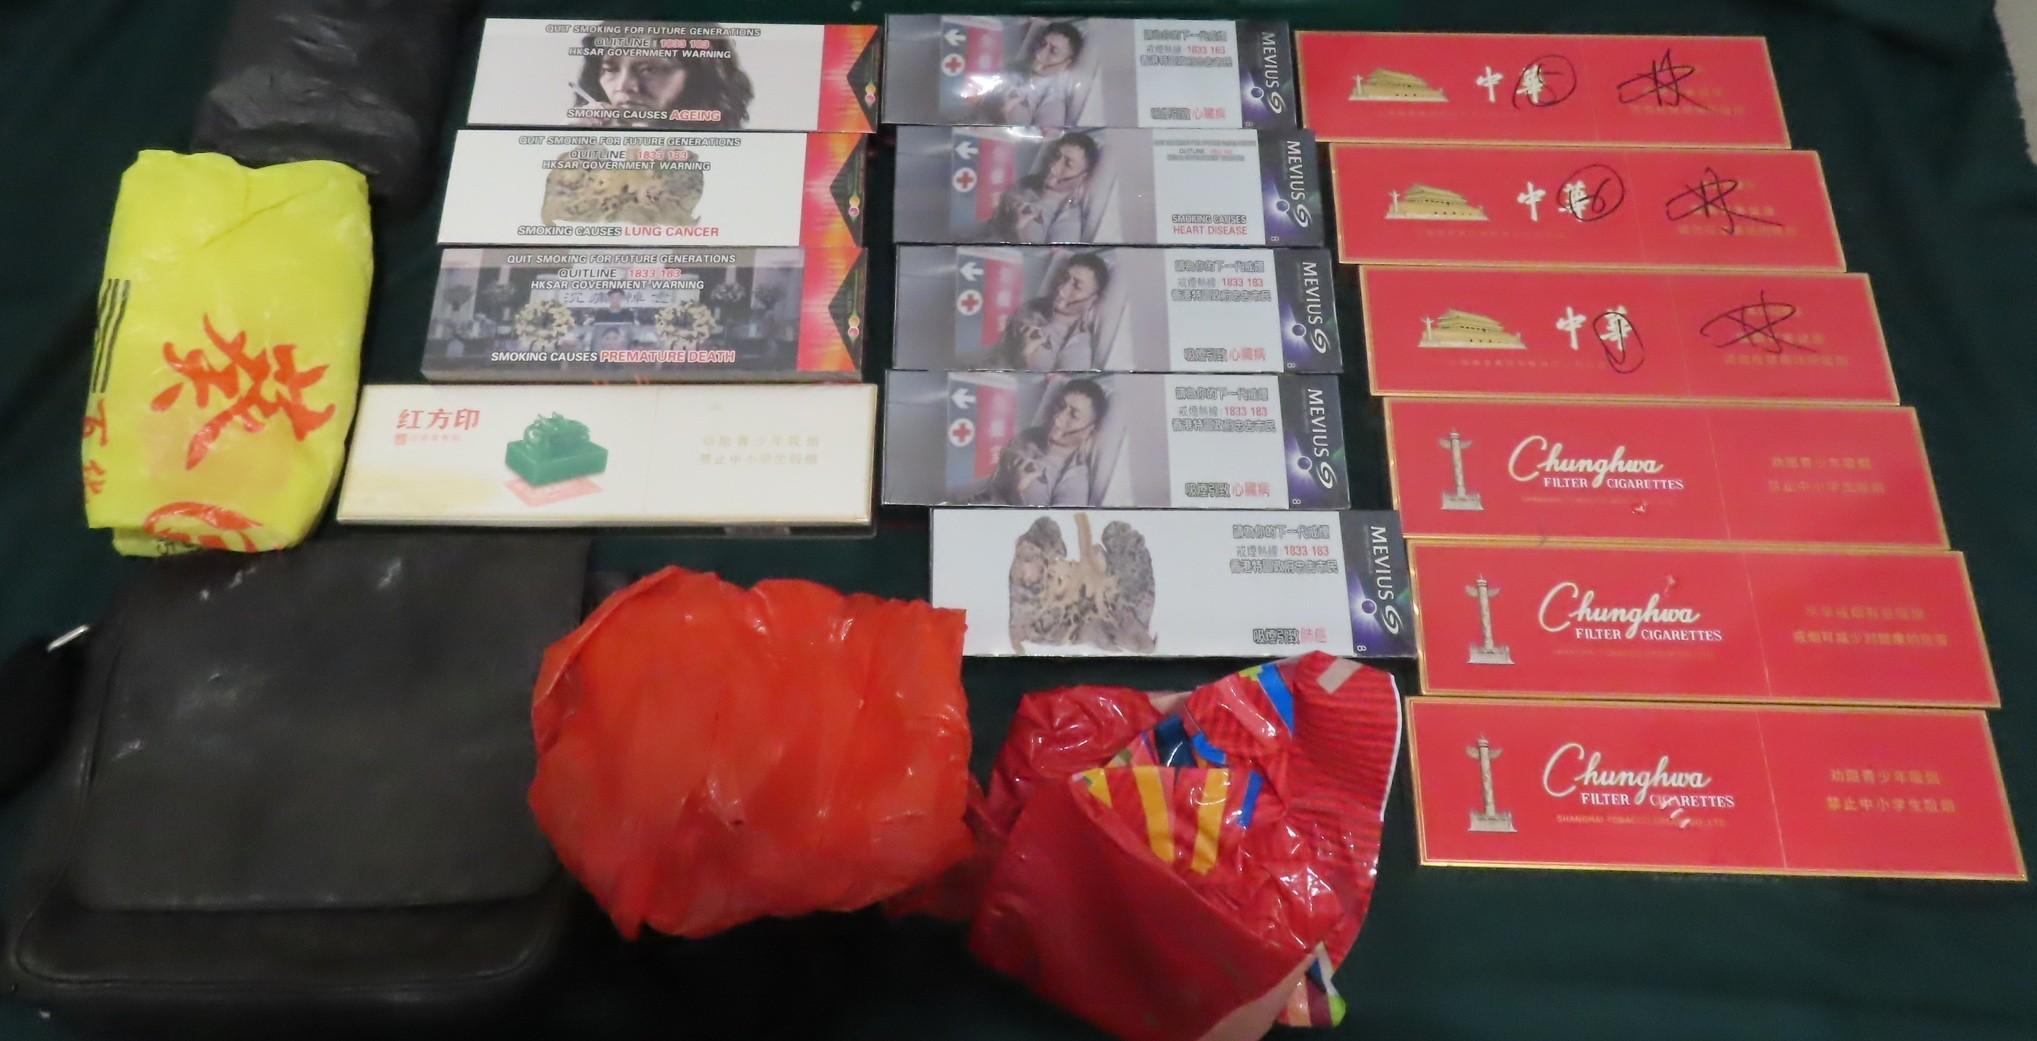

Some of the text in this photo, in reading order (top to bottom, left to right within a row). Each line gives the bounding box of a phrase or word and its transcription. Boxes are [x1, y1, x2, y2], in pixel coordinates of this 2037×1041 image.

[545, 24, 762, 37] QUIT SMOKING FOR FUTURE GENERATIONS
[594, 37, 650, 48] QUITLINE
[568, 48, 732, 59] HKSAR GOVERNMENT WARNING
[1261, 31, 1280, 89] MEVIUS
[567, 108, 722, 121] SMOKING CAUSES AGEING
[518, 136, 742, 147] QUIT SMOKING FOR FUTURE GENERATIONS
[569, 150, 626, 160] QUITLINE
[542, 160, 711, 171] HKSAR GOVERNMENT WARNING
[1286, 140, 1306, 201] MEVIUS
[1171, 214, 1247, 225] SMOKING CAUSES
[517, 226, 719, 237] SMOKING CAUSES LUNG CANCER
[1173, 225, 1248, 236] HEART DISEASE
[507, 254, 736, 264] QUIT SMOKING FOR FUTURE GENERATIONS
[558, 268, 682, 279] QUITLINE 1833 183
[530, 280, 705, 290] HKSAR GOVERNMENT WARNING
[1222, 277, 1244, 287] 1833
[1247, 277, 1264, 287] 183
[1302, 261, 1323, 325] MEVIUS
[490, 350, 736, 363] SMOKING CAUSES PREMATURE DEATH
[1224, 405, 1247, 417] 1833
[1250, 405, 1268, 417] 183
[396, 408, 481, 431] 红方印
[1307, 388, 1330, 458] MEVIUS
[1508, 434, 1664, 489] Chunghwa
[1543, 477, 1685, 490] FILTER CIGARETTES
[1284, 545, 1308, 557] 1833
[1312, 545, 1329, 557] 183
[1370, 526, 1395, 601] MEVIUS
[1538, 581, 1701, 639] Chunghwa
[1575, 628, 1723, 641] FILTER CIGARETTES
[1356, 644, 1367, 652] 8
[1542, 741, 1712, 805] Chunghwa
[1580, 792, 1631, 805] FILTER
